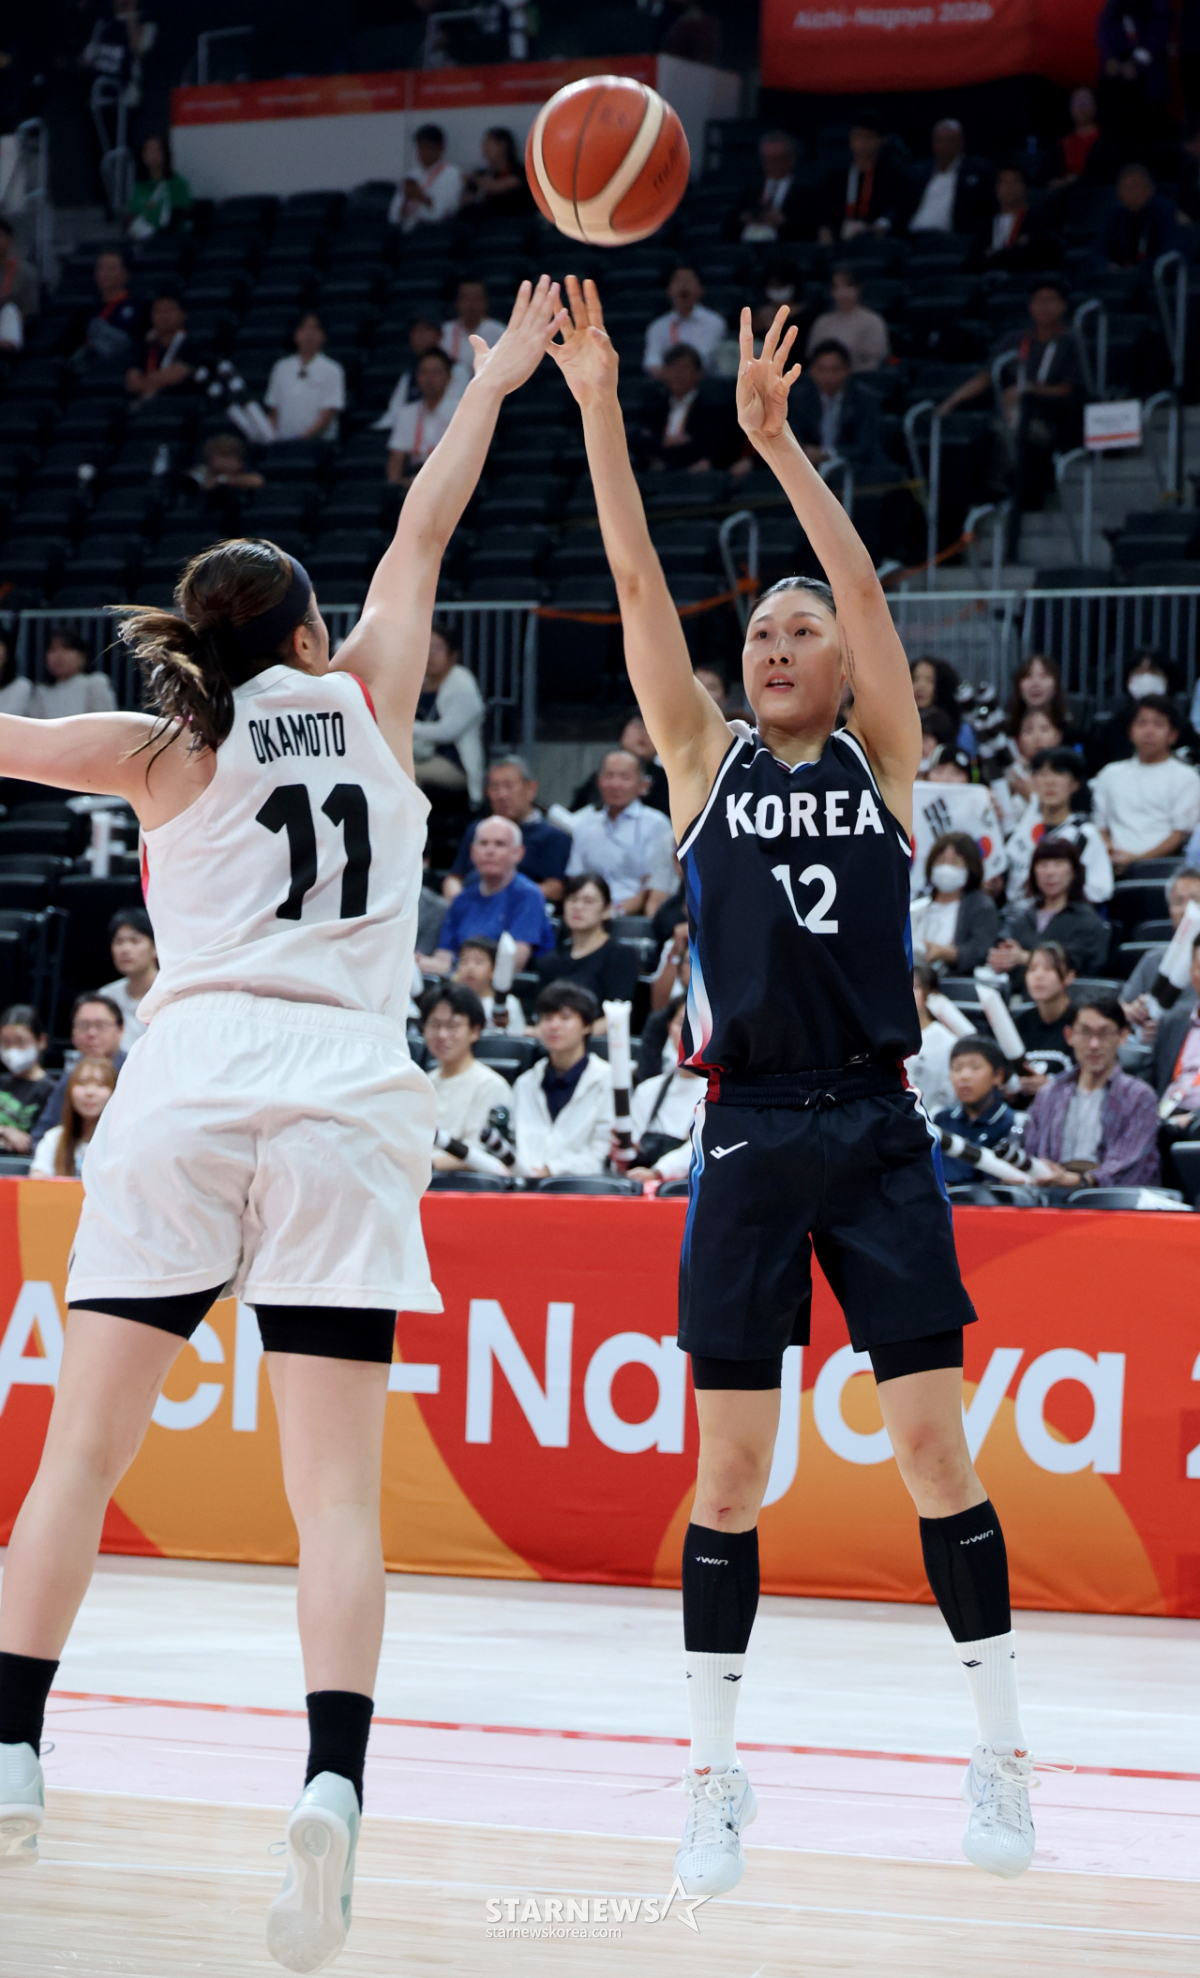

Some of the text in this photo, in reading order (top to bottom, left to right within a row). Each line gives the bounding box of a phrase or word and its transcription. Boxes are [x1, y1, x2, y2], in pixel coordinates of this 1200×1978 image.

[793, 1, 994, 31] Aichi-Nagoya 2026
[249, 711, 346, 764] OKAMOTO
[726, 789, 885, 839] KOREA
[255, 783, 372, 920] 11
[770, 863, 839, 934] 12
[0, 1281, 1126, 1508] Ac-Naoya
